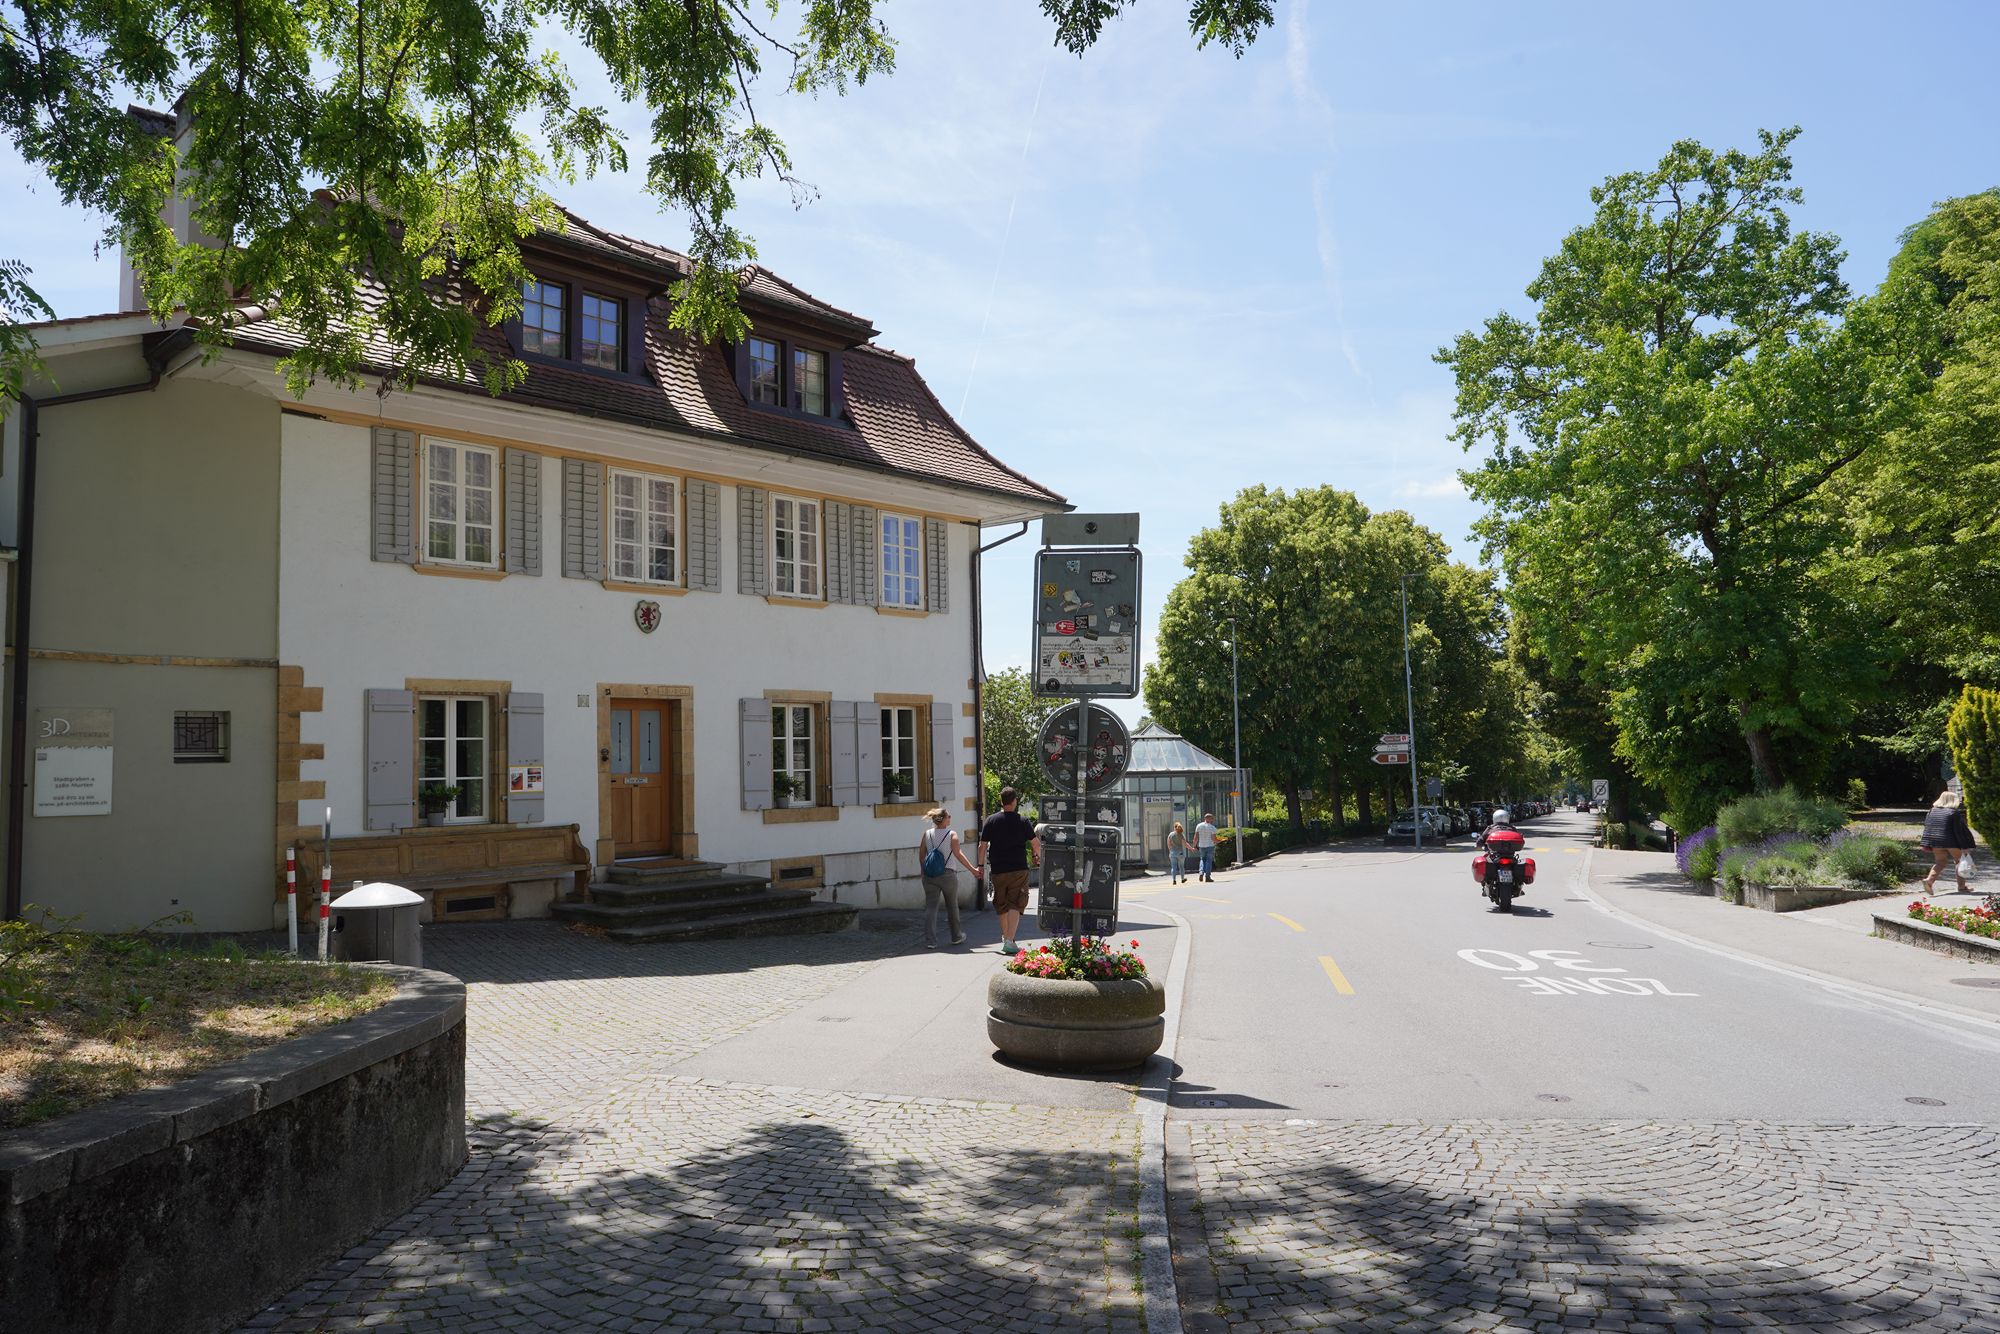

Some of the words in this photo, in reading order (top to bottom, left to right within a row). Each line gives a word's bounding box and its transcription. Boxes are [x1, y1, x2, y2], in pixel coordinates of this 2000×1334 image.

[40, 718, 70, 738] 3D
[1456, 948, 1629, 972] 30
[1501, 976, 1700, 996] ZONE
